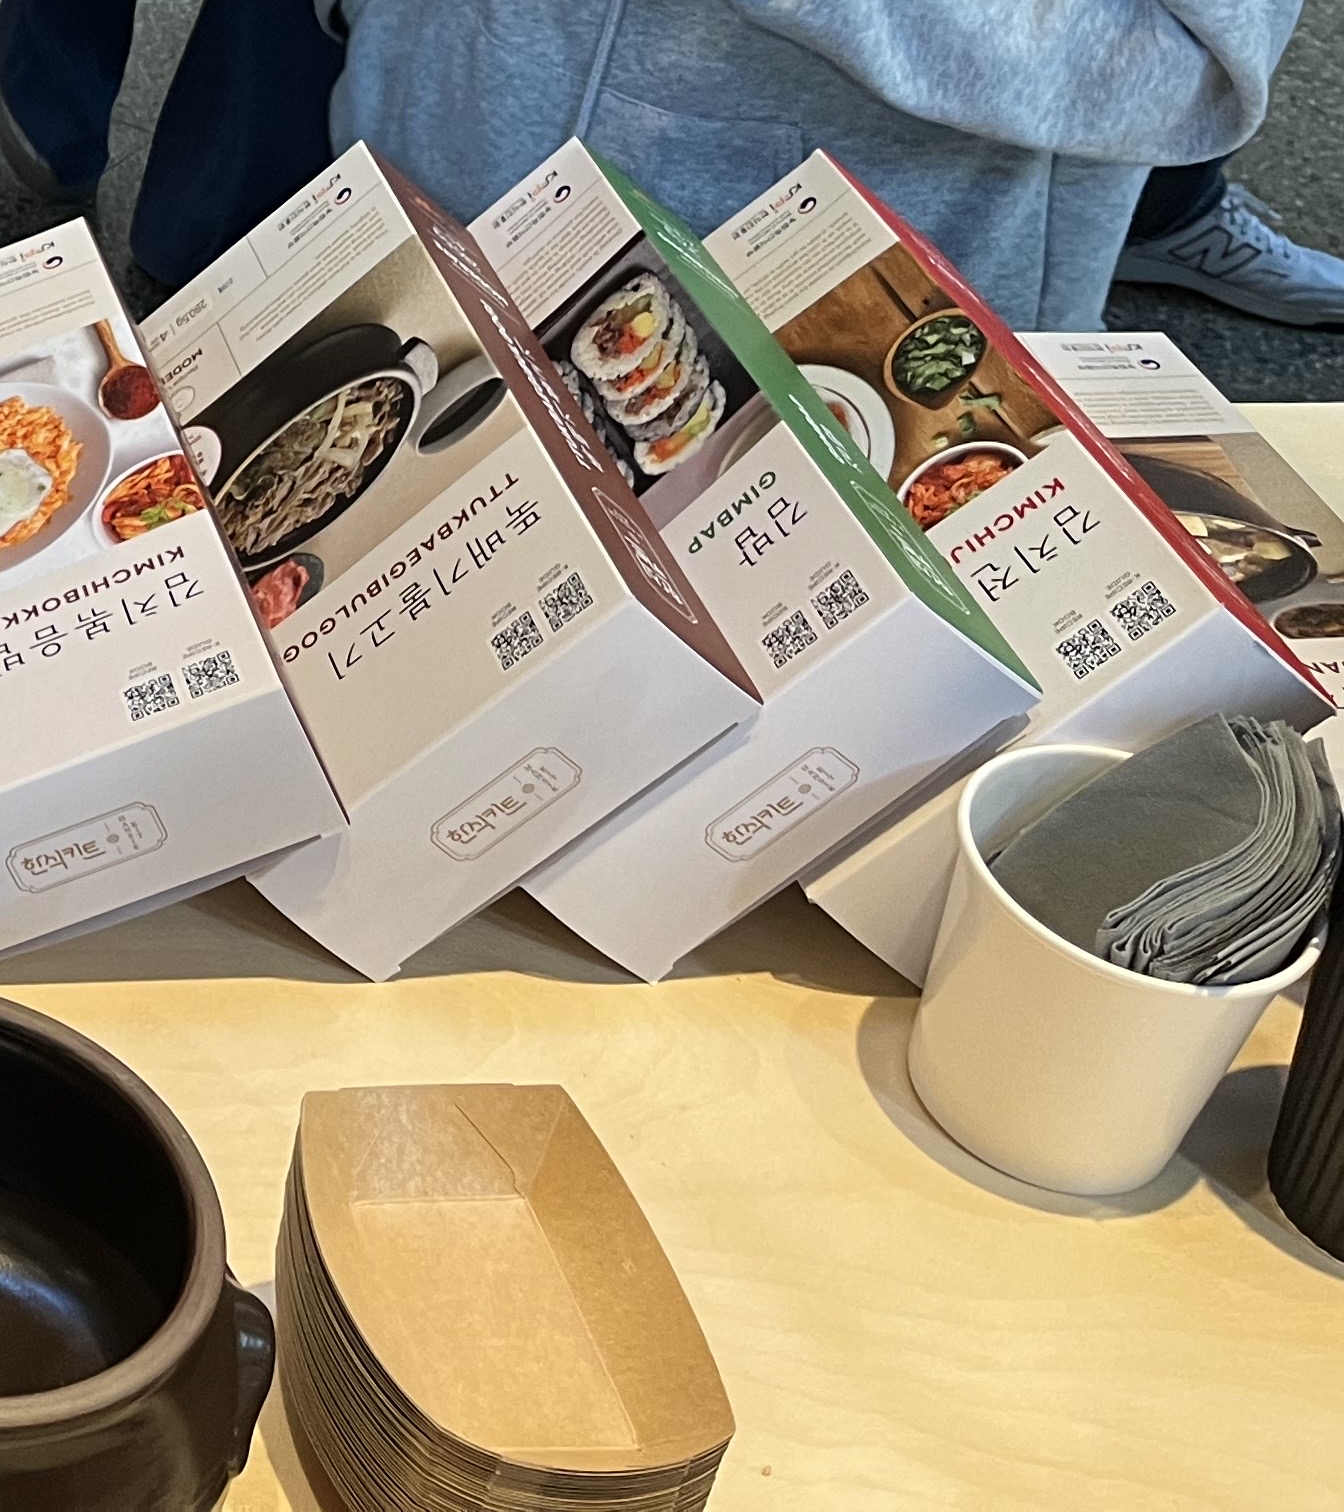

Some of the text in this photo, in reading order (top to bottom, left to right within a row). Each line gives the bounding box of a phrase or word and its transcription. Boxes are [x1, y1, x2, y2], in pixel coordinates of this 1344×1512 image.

[688, 470, 777, 554] GIMBAP
[733, 495, 808, 566] 김밥
[322, 501, 542, 681] 뚝배기불고기
[969, 504, 1099, 604] 김치전
[446, 796, 526, 844] 한식키트
[722, 795, 803, 845] 한식키트
